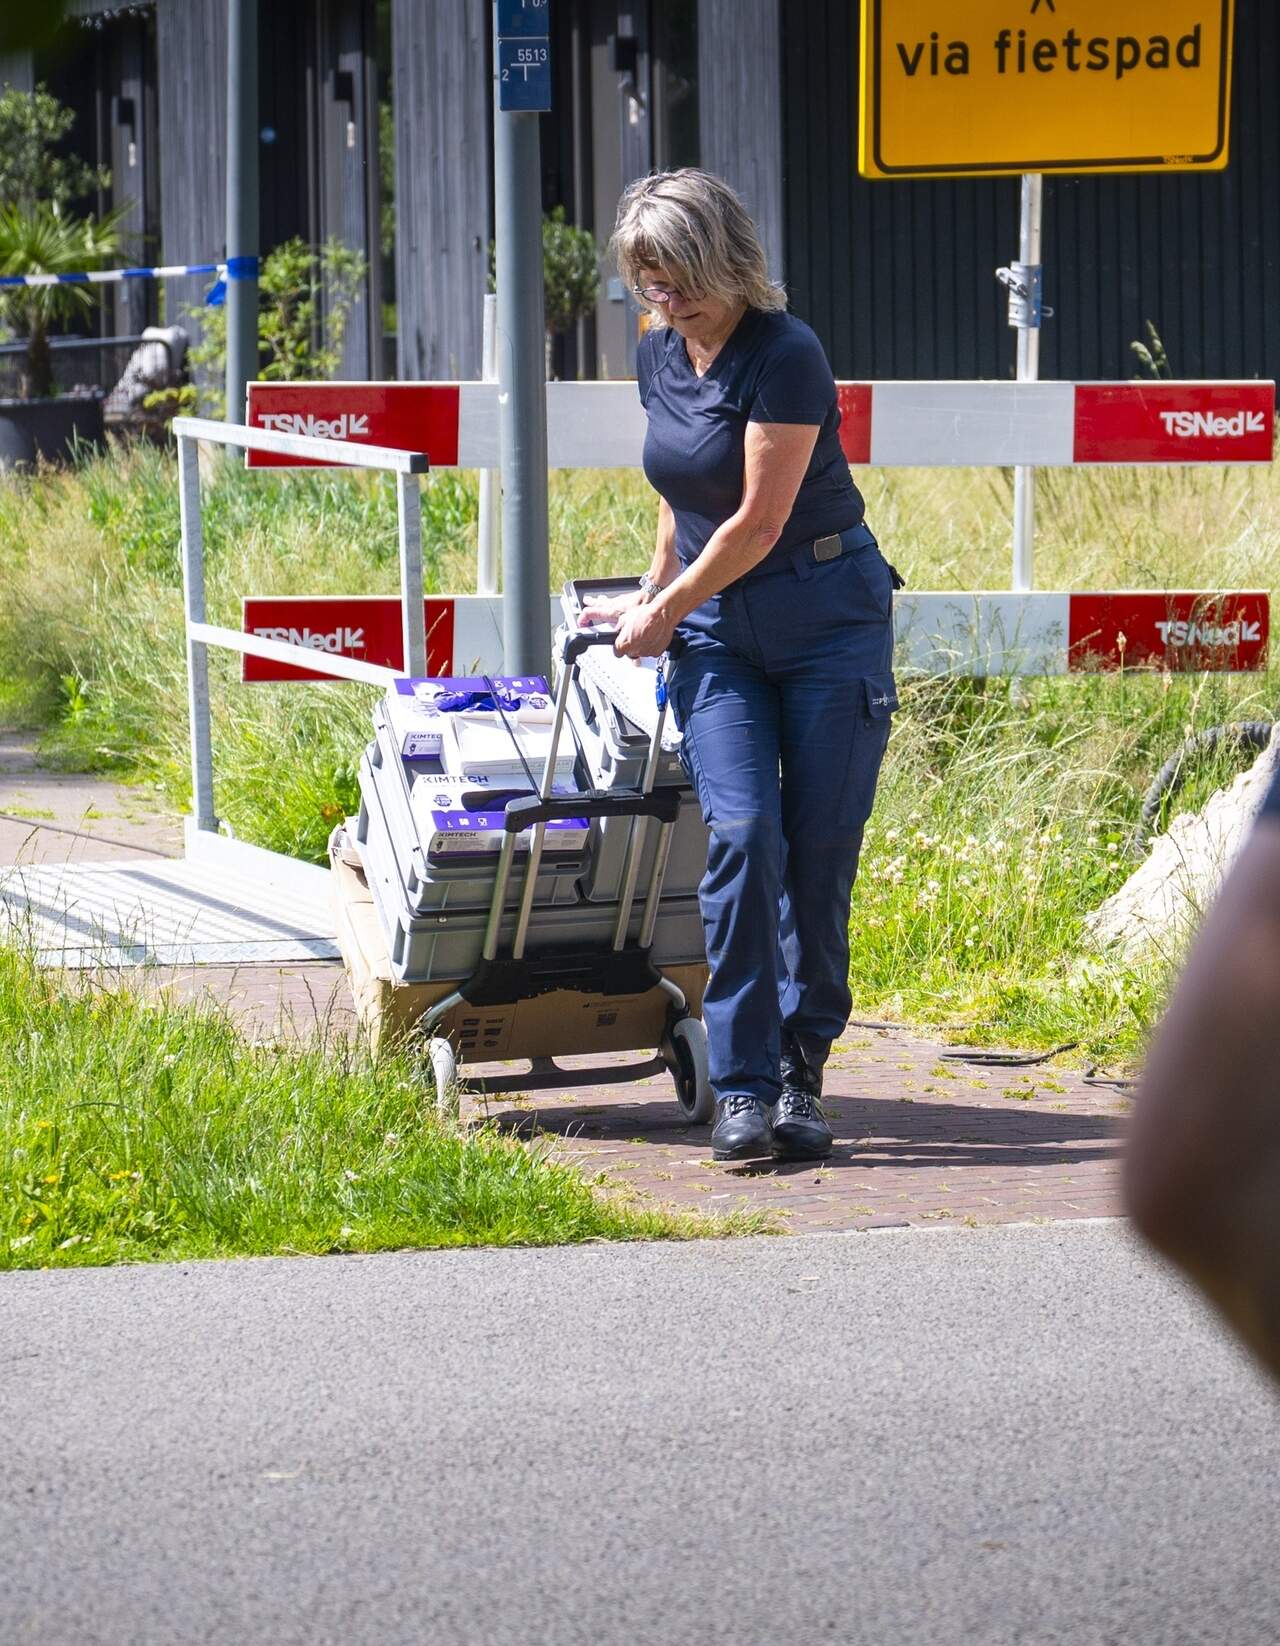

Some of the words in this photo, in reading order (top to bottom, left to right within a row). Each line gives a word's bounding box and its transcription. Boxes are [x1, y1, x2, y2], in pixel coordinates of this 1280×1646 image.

[517, 48, 547, 62] 5513
[895, 31, 970, 77] via
[994, 23, 1202, 80] fietspad
[501, 68, 510, 81] 2
[257, 413, 348, 439] TSNed
[1159, 411, 1244, 437] TSNed
[422, 775, 489, 784] KIMTECH
